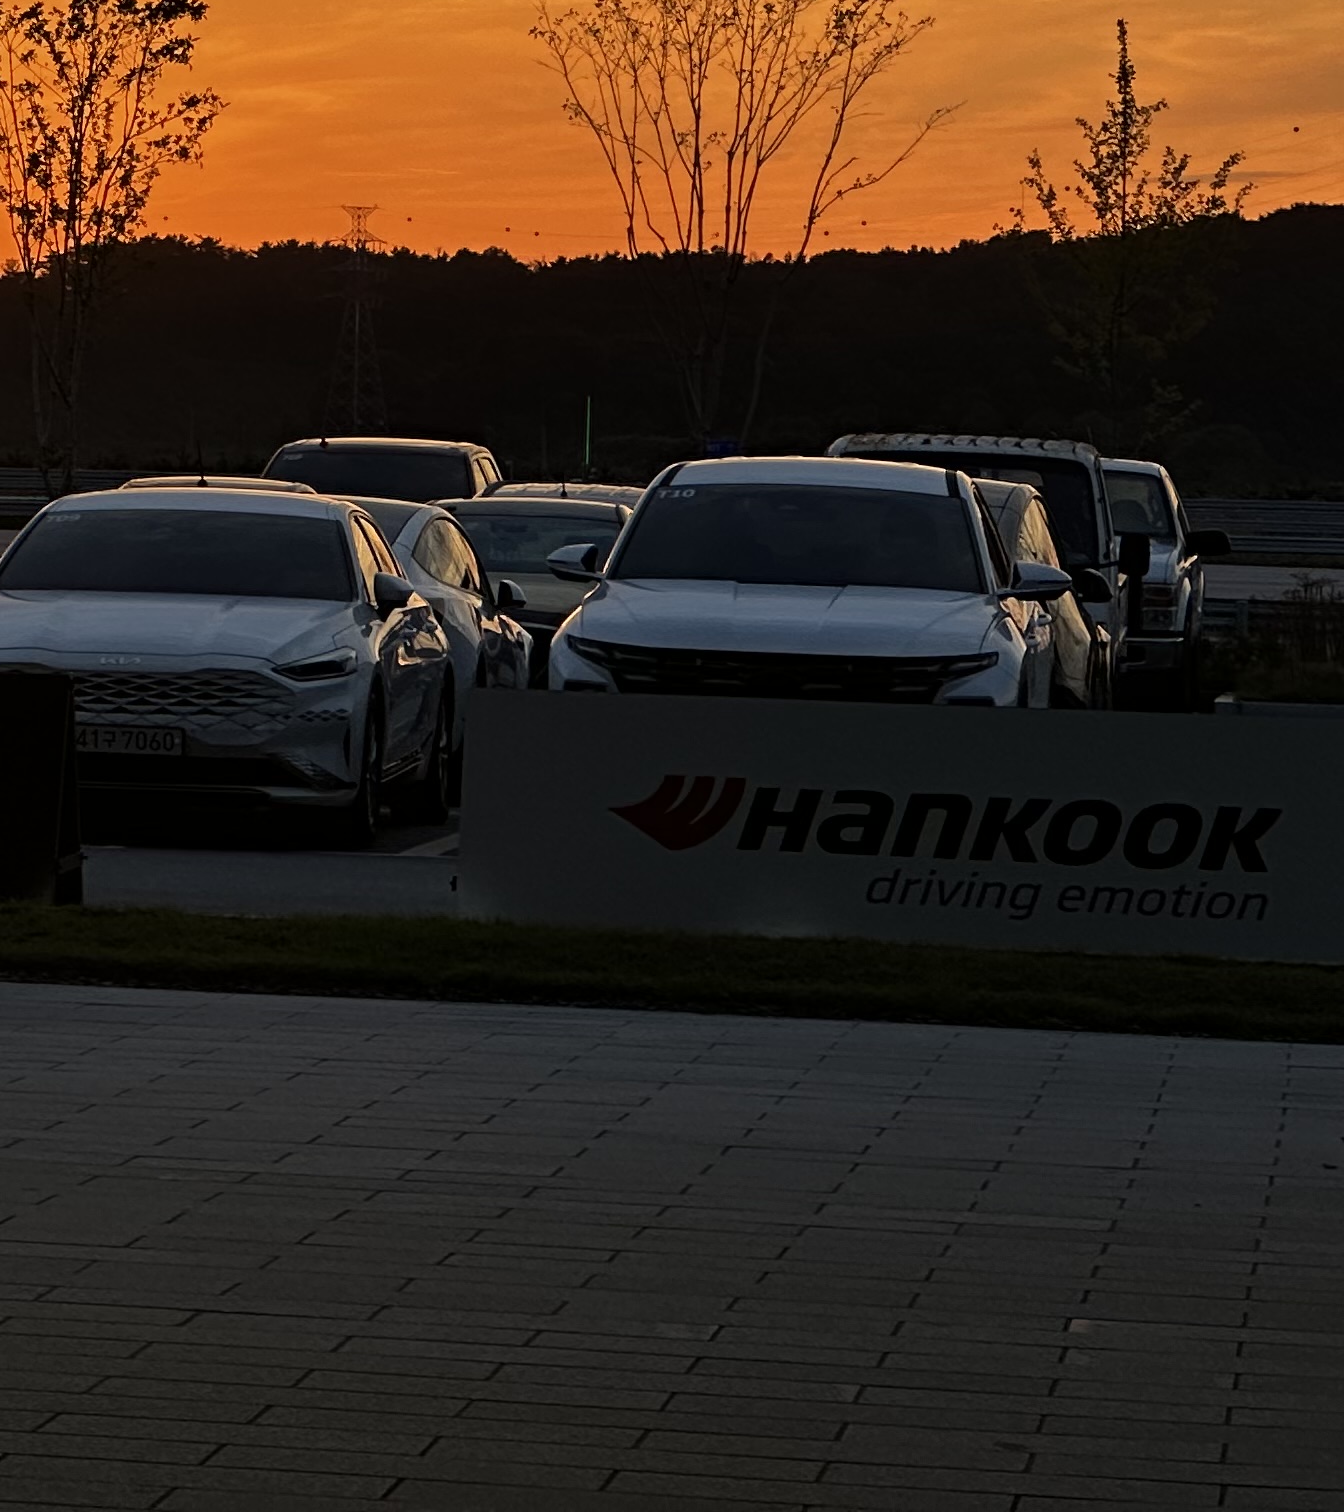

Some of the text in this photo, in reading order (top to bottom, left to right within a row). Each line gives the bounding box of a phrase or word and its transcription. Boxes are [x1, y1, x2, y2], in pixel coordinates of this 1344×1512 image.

[657, 489, 696, 499] T10
[865, 869, 1269, 921] driving emotion
